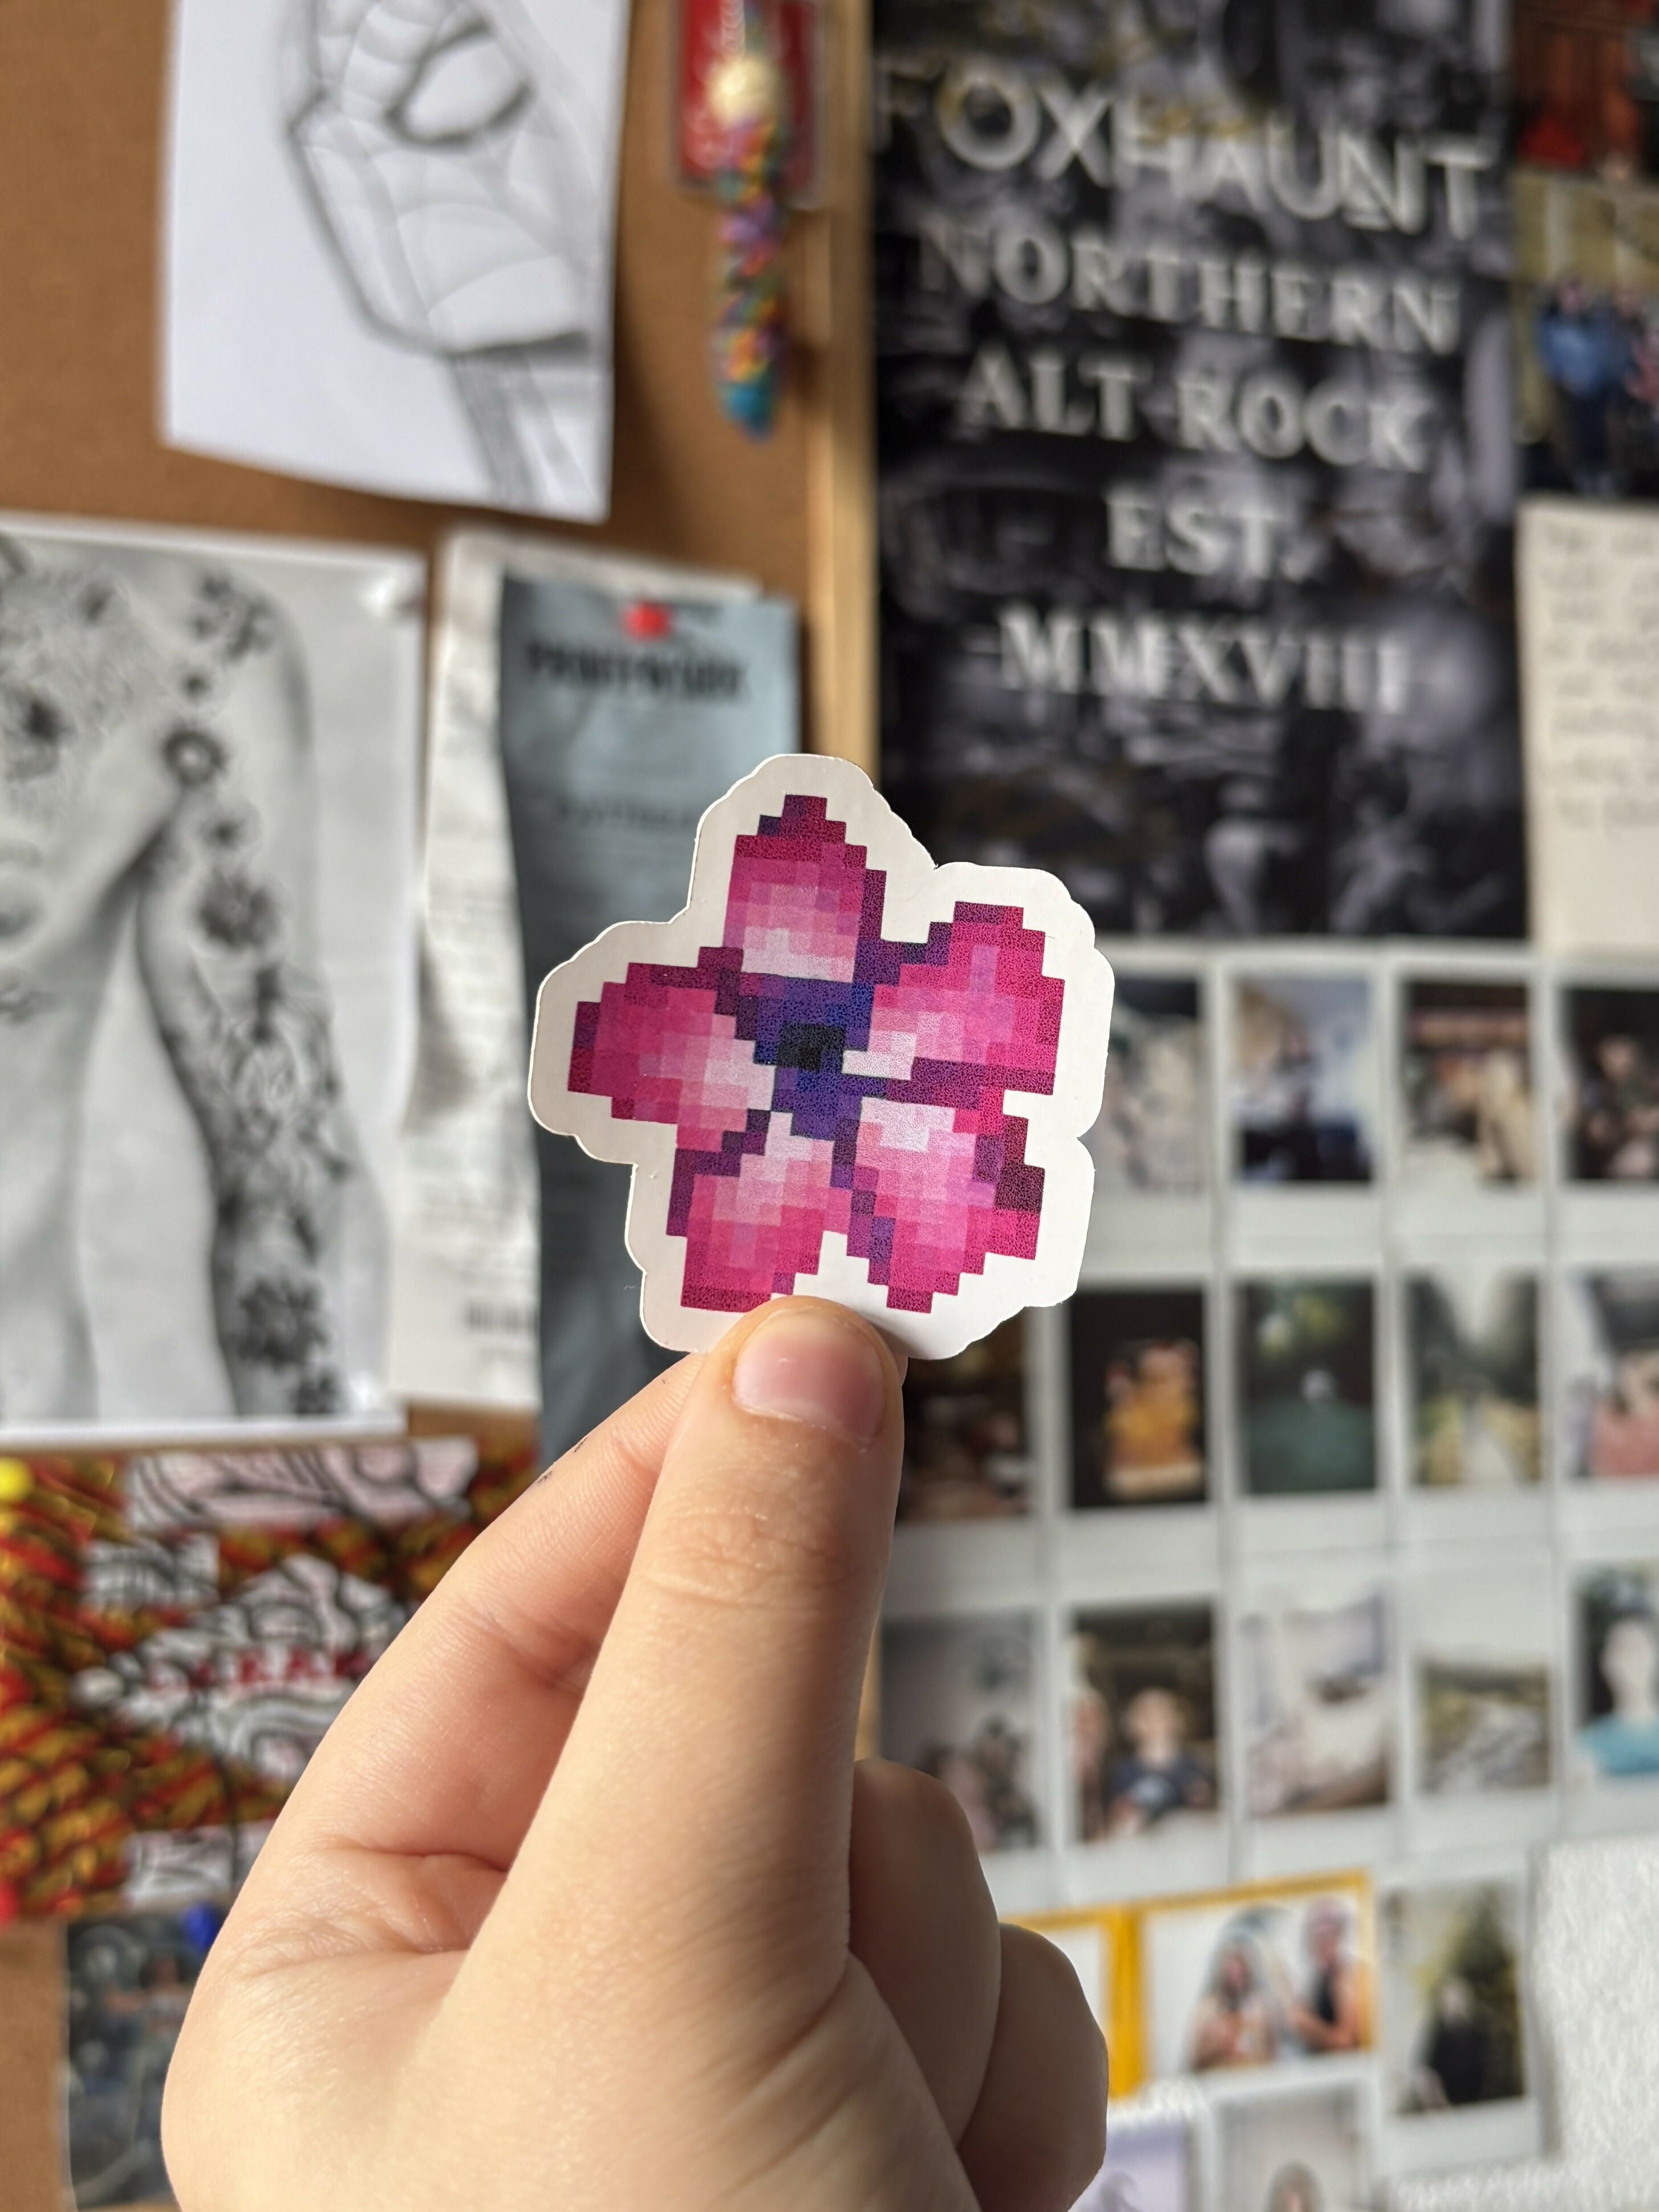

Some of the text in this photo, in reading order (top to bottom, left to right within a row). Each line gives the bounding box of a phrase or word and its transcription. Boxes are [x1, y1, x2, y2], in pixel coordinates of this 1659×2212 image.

[919, 208, 1461, 354] NORTHERN
[956, 347, 1430, 472] ALT ROCK
